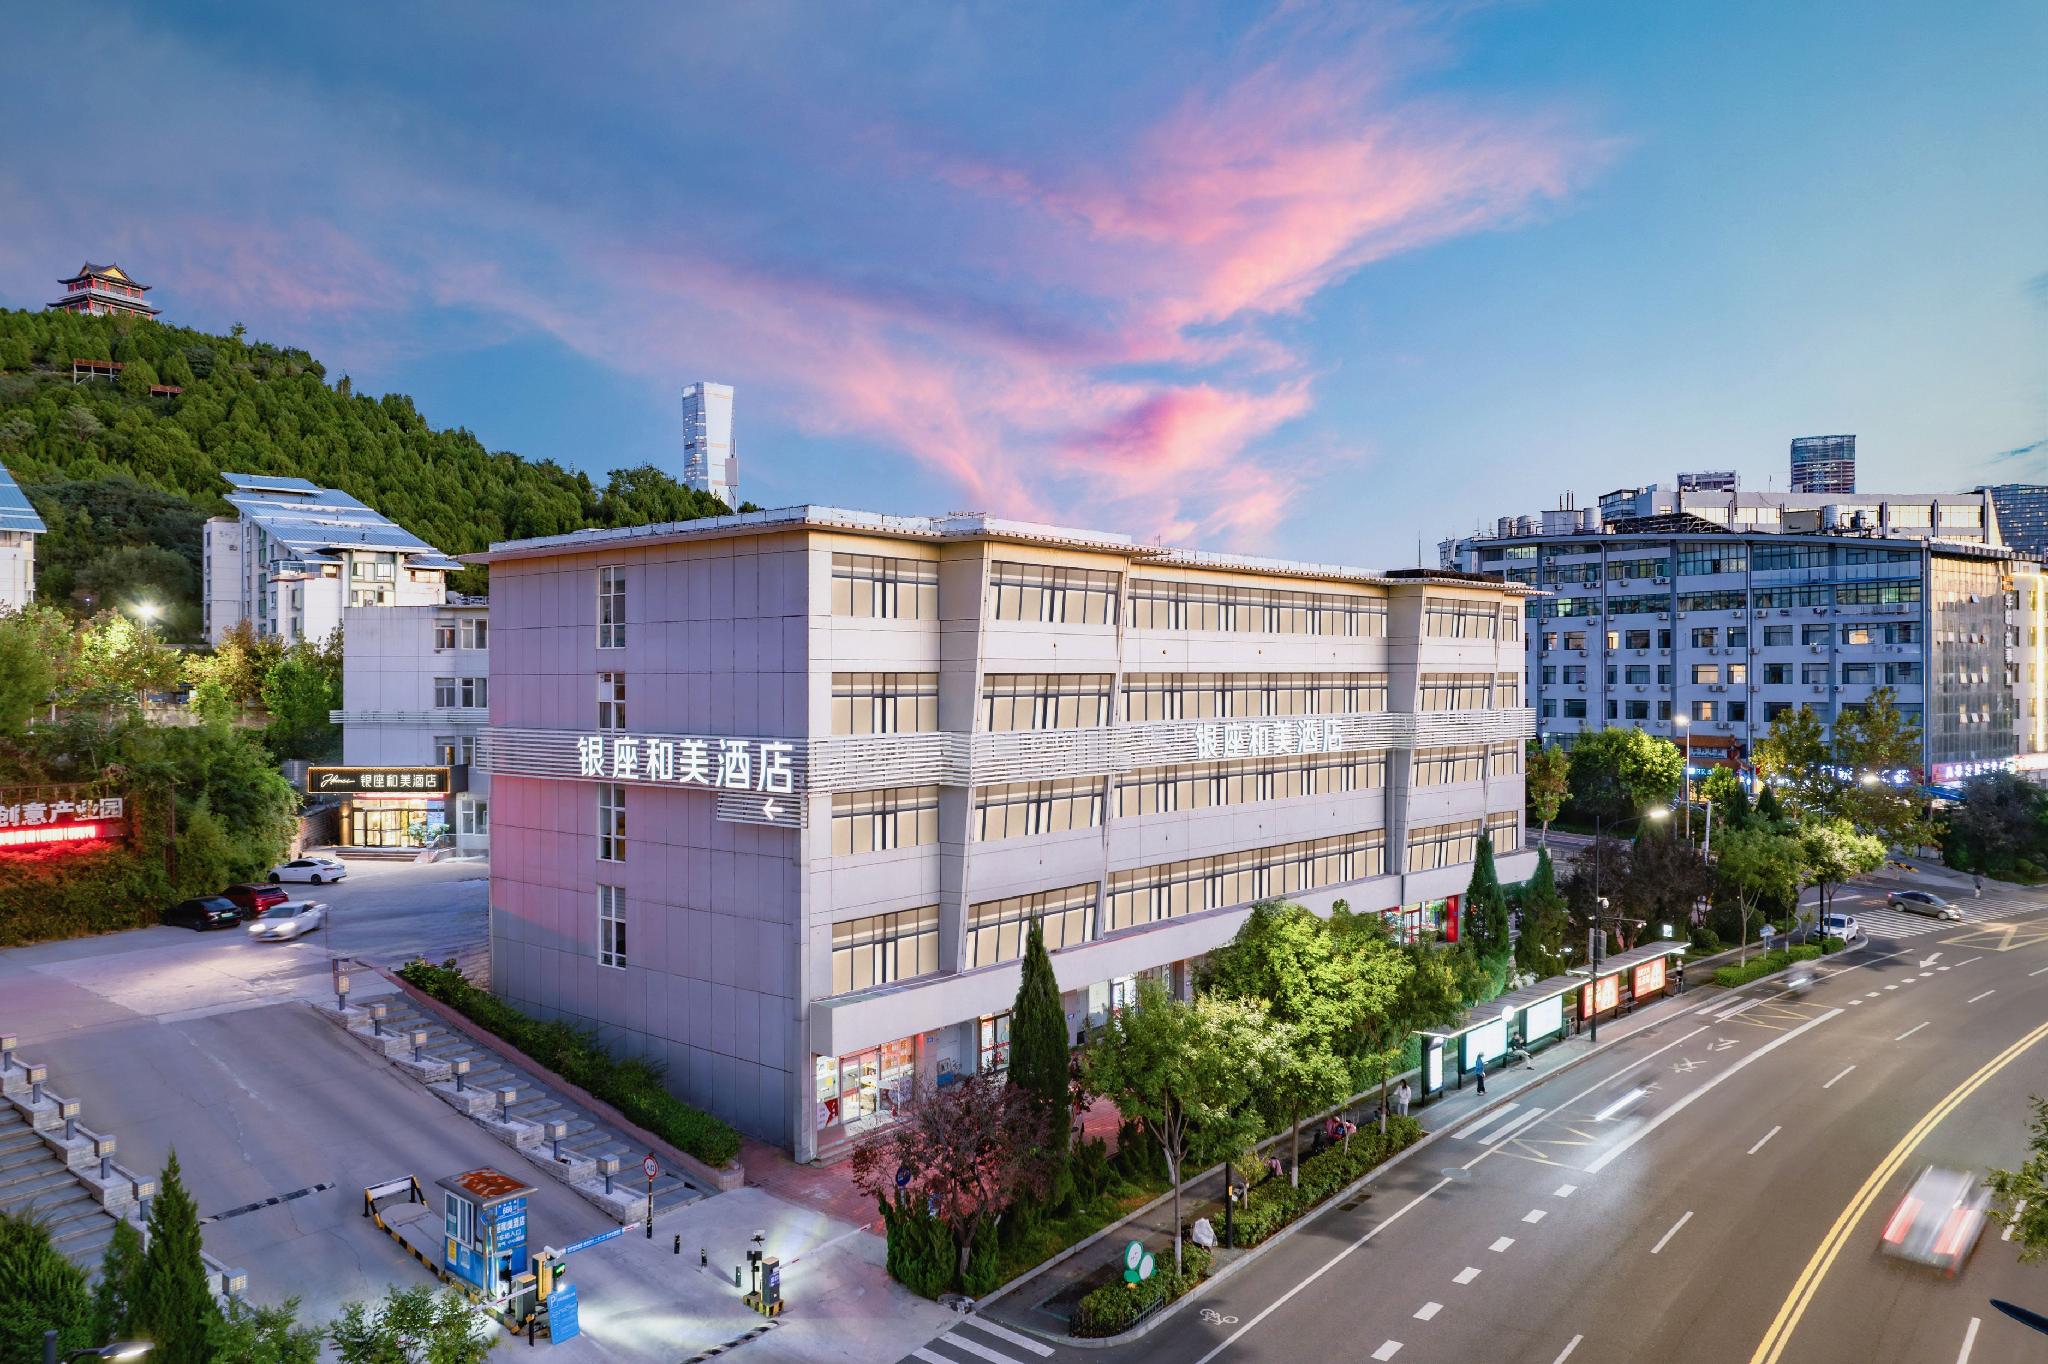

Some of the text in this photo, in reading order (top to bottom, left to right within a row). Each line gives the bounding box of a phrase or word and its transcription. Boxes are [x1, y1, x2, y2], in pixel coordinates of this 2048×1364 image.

[1195, 719, 1342, 760] 银座和美酒店
[360, 774, 437, 788] 银座和美酒店
[578, 736, 794, 794] 银座和美酒店
[0, 797, 123, 828] 创意产业园
